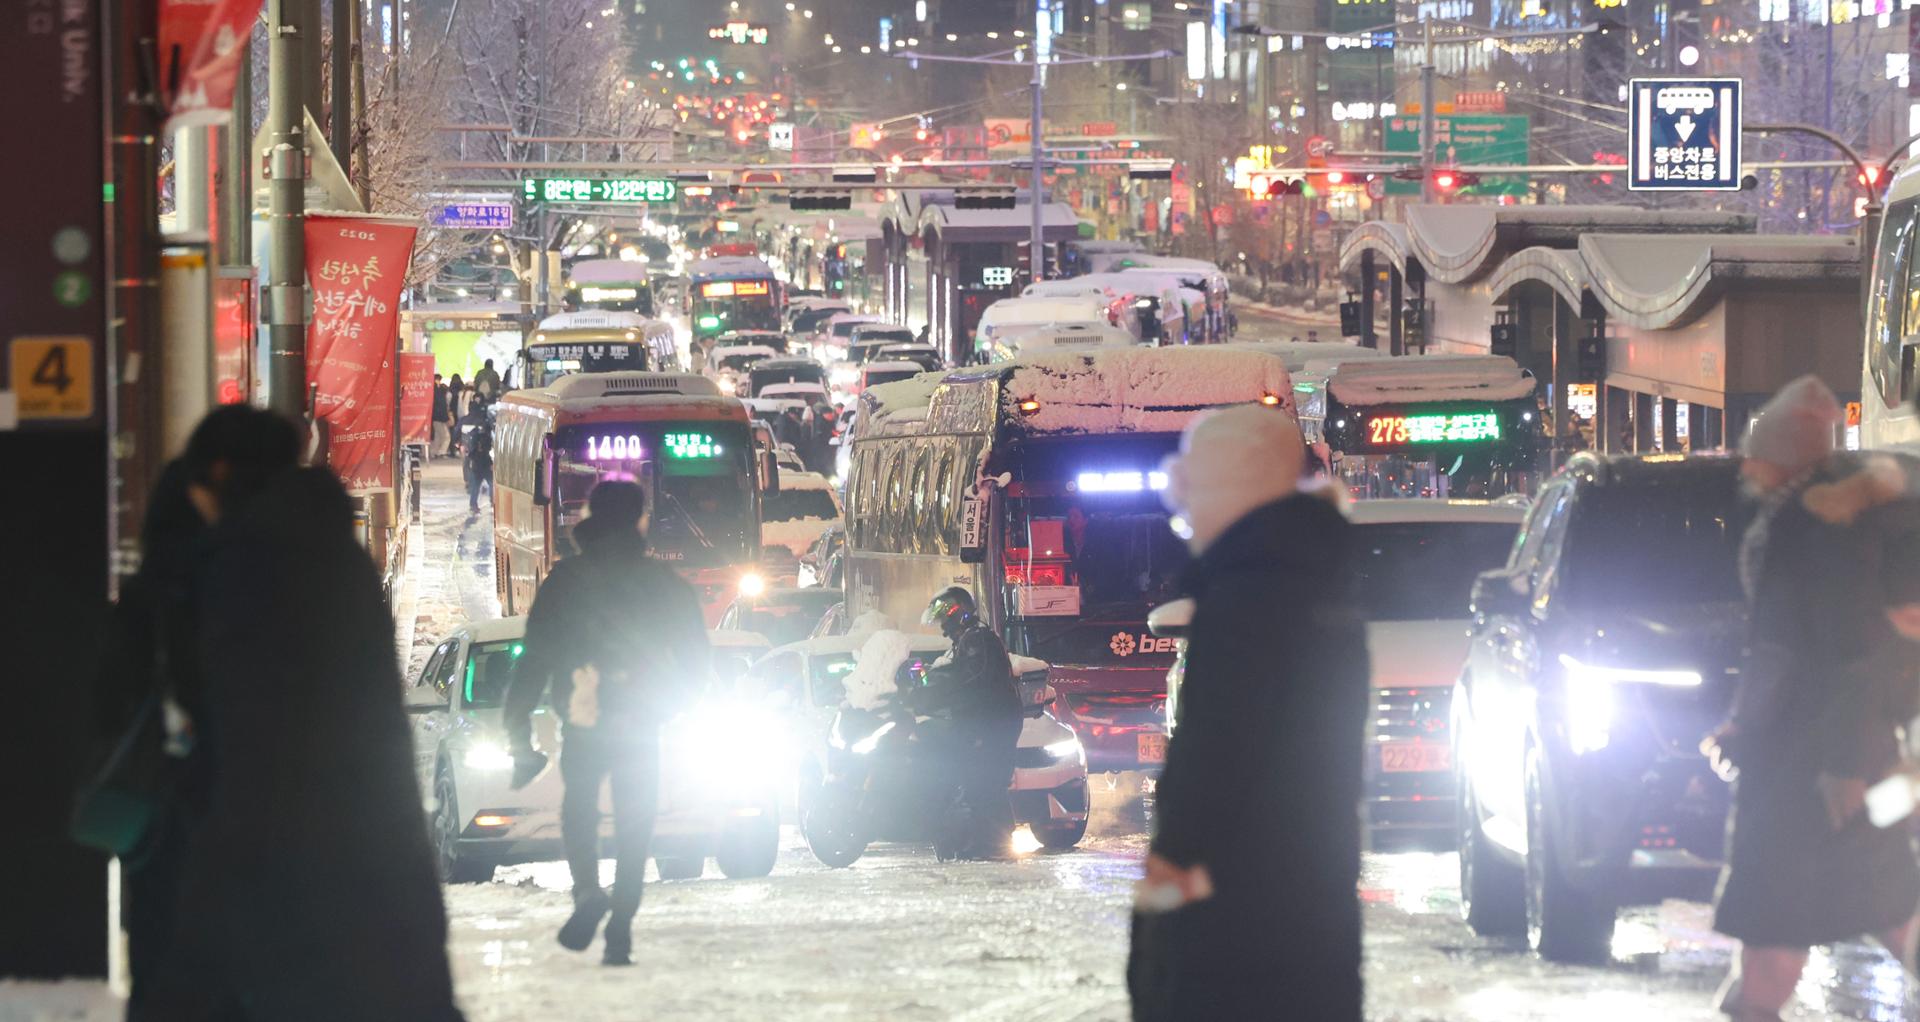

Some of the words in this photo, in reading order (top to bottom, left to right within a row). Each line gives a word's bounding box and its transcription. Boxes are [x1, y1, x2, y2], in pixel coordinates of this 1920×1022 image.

[1654, 146, 1716, 164] 중앙차로
[1654, 163, 1716, 181] 버스전용
[31, 345, 74, 395] 4
[1371, 417, 1406, 443] 273
[588, 434, 641, 460] 1400
[966, 502, 977, 532] 서울
[964, 532, 975, 545] 12
